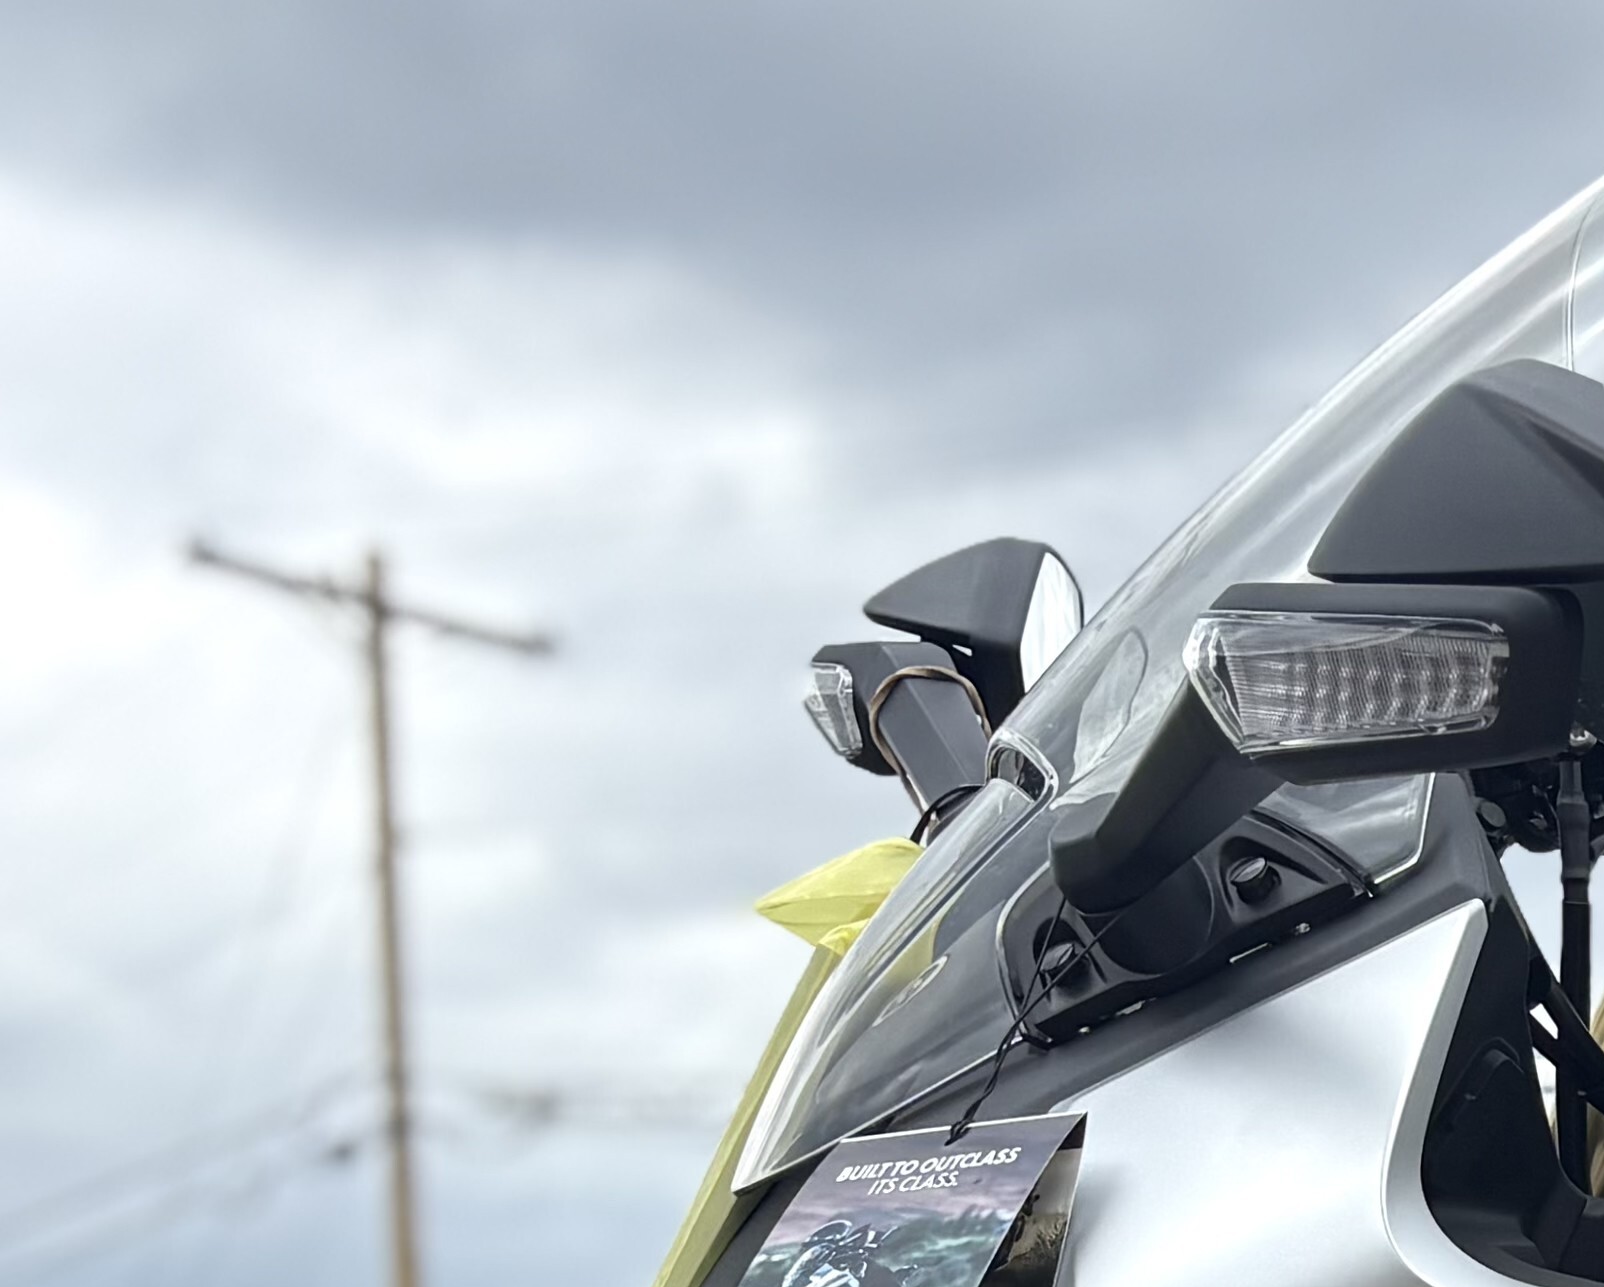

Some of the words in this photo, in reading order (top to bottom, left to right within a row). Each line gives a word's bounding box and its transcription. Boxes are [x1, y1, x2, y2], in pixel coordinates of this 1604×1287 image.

[836, 1162, 887, 1183] BUILT
[888, 1159, 919, 1177] TO
[919, 1147, 1022, 1173] OUTCLASS
[867, 1178, 896, 1195] ITS
[899, 1171, 959, 1192] CLASS.
